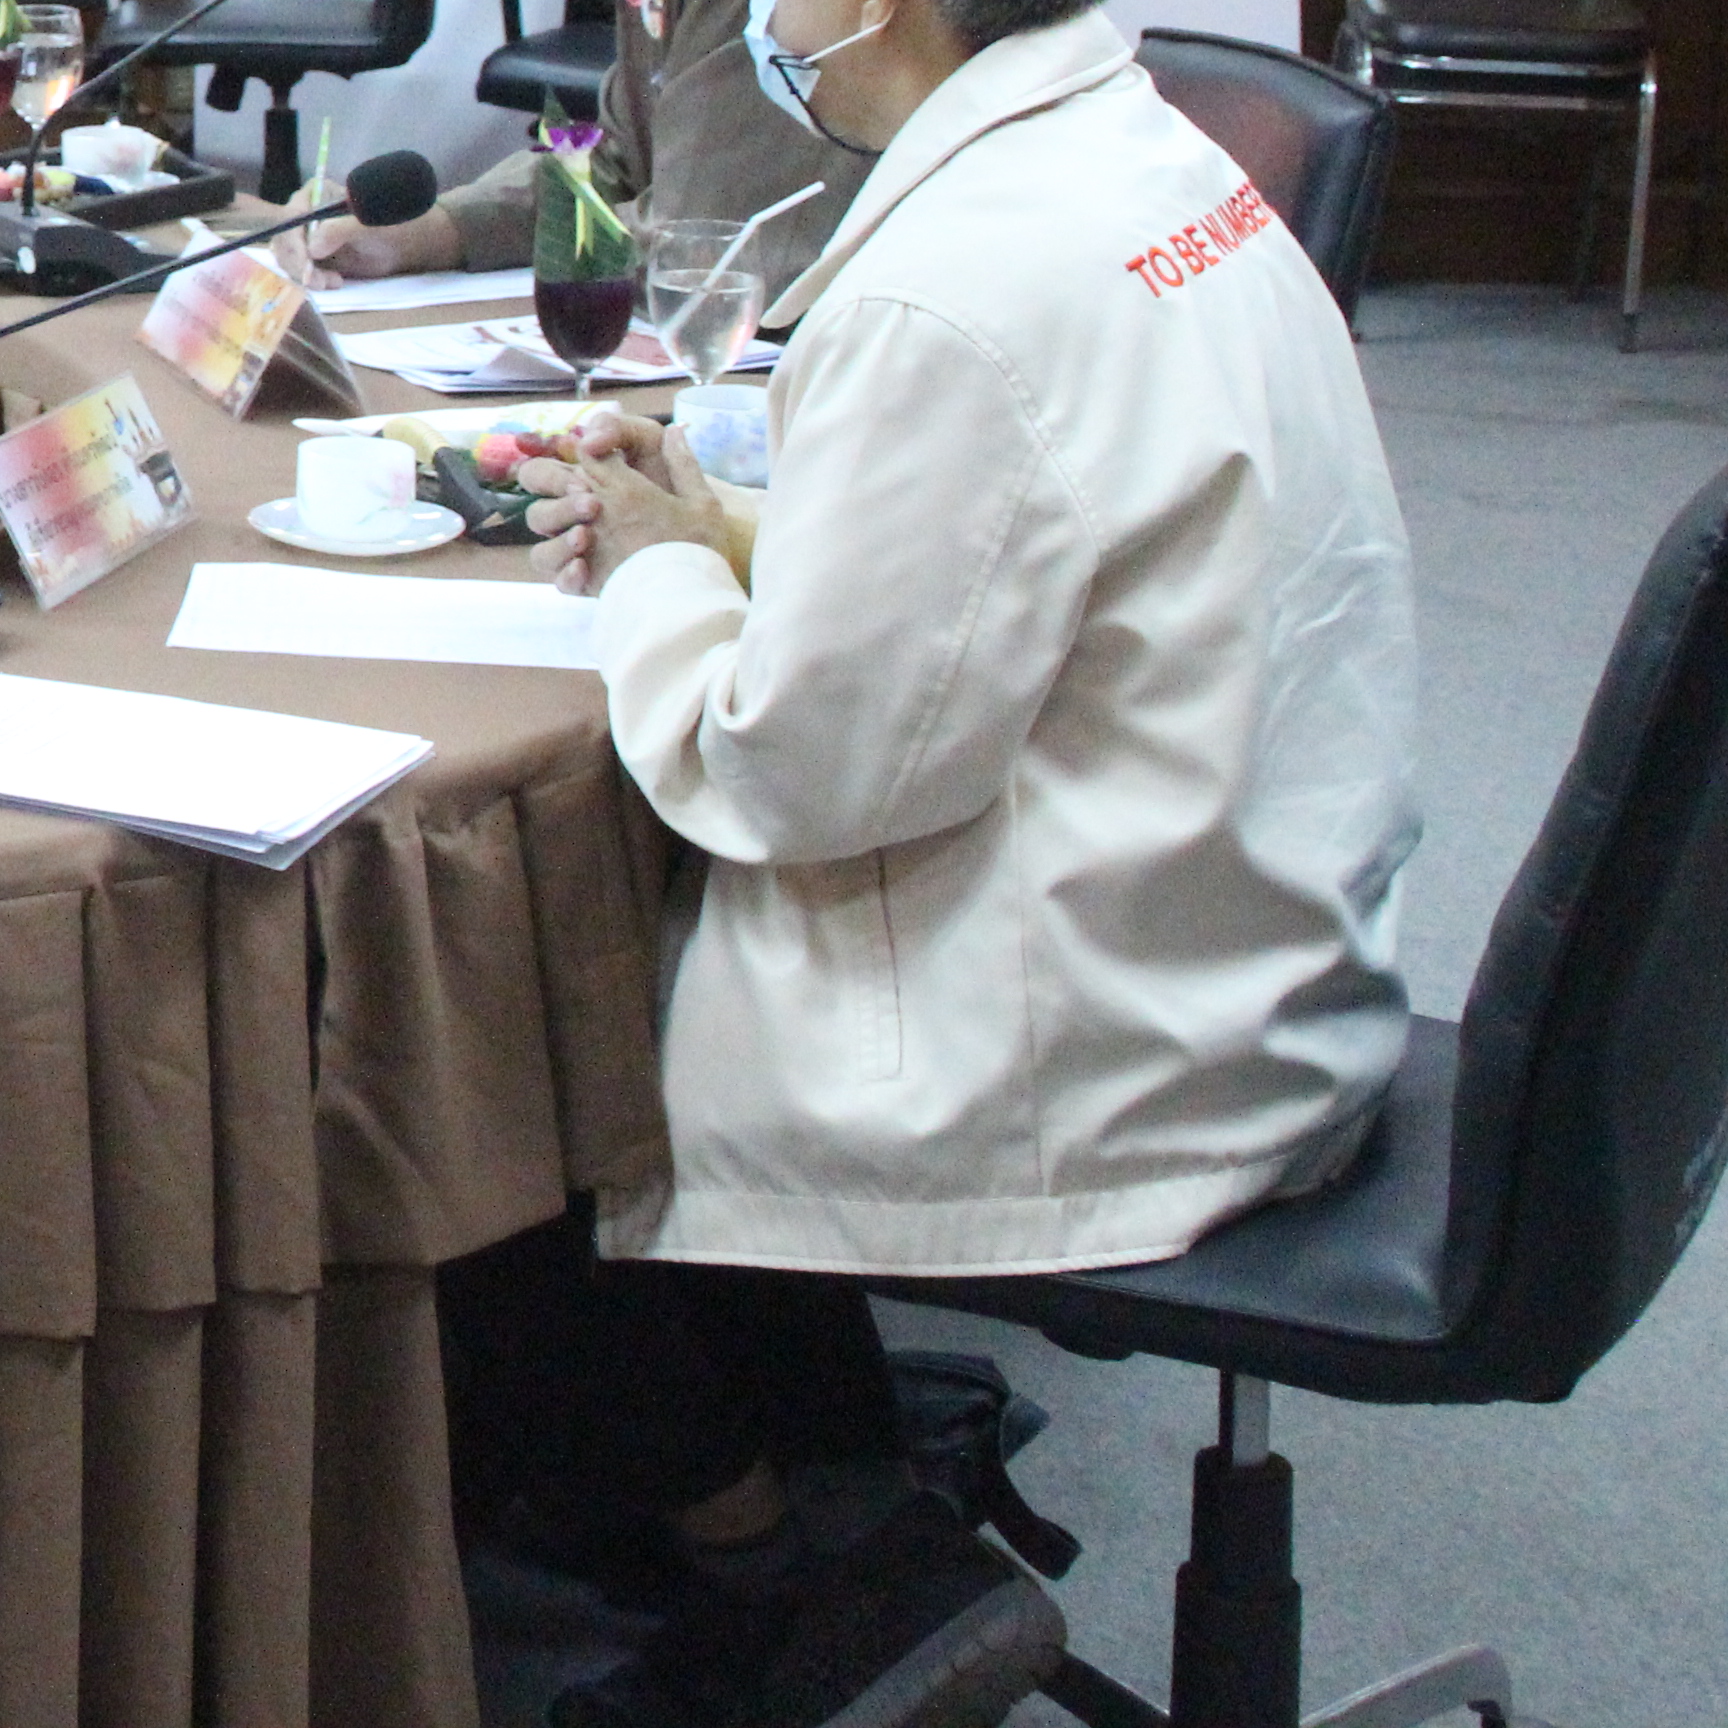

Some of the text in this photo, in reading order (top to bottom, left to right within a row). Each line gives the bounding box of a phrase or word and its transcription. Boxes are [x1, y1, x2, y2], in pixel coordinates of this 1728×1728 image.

[1124, 179, 1277, 299] TO BE NUMBE
